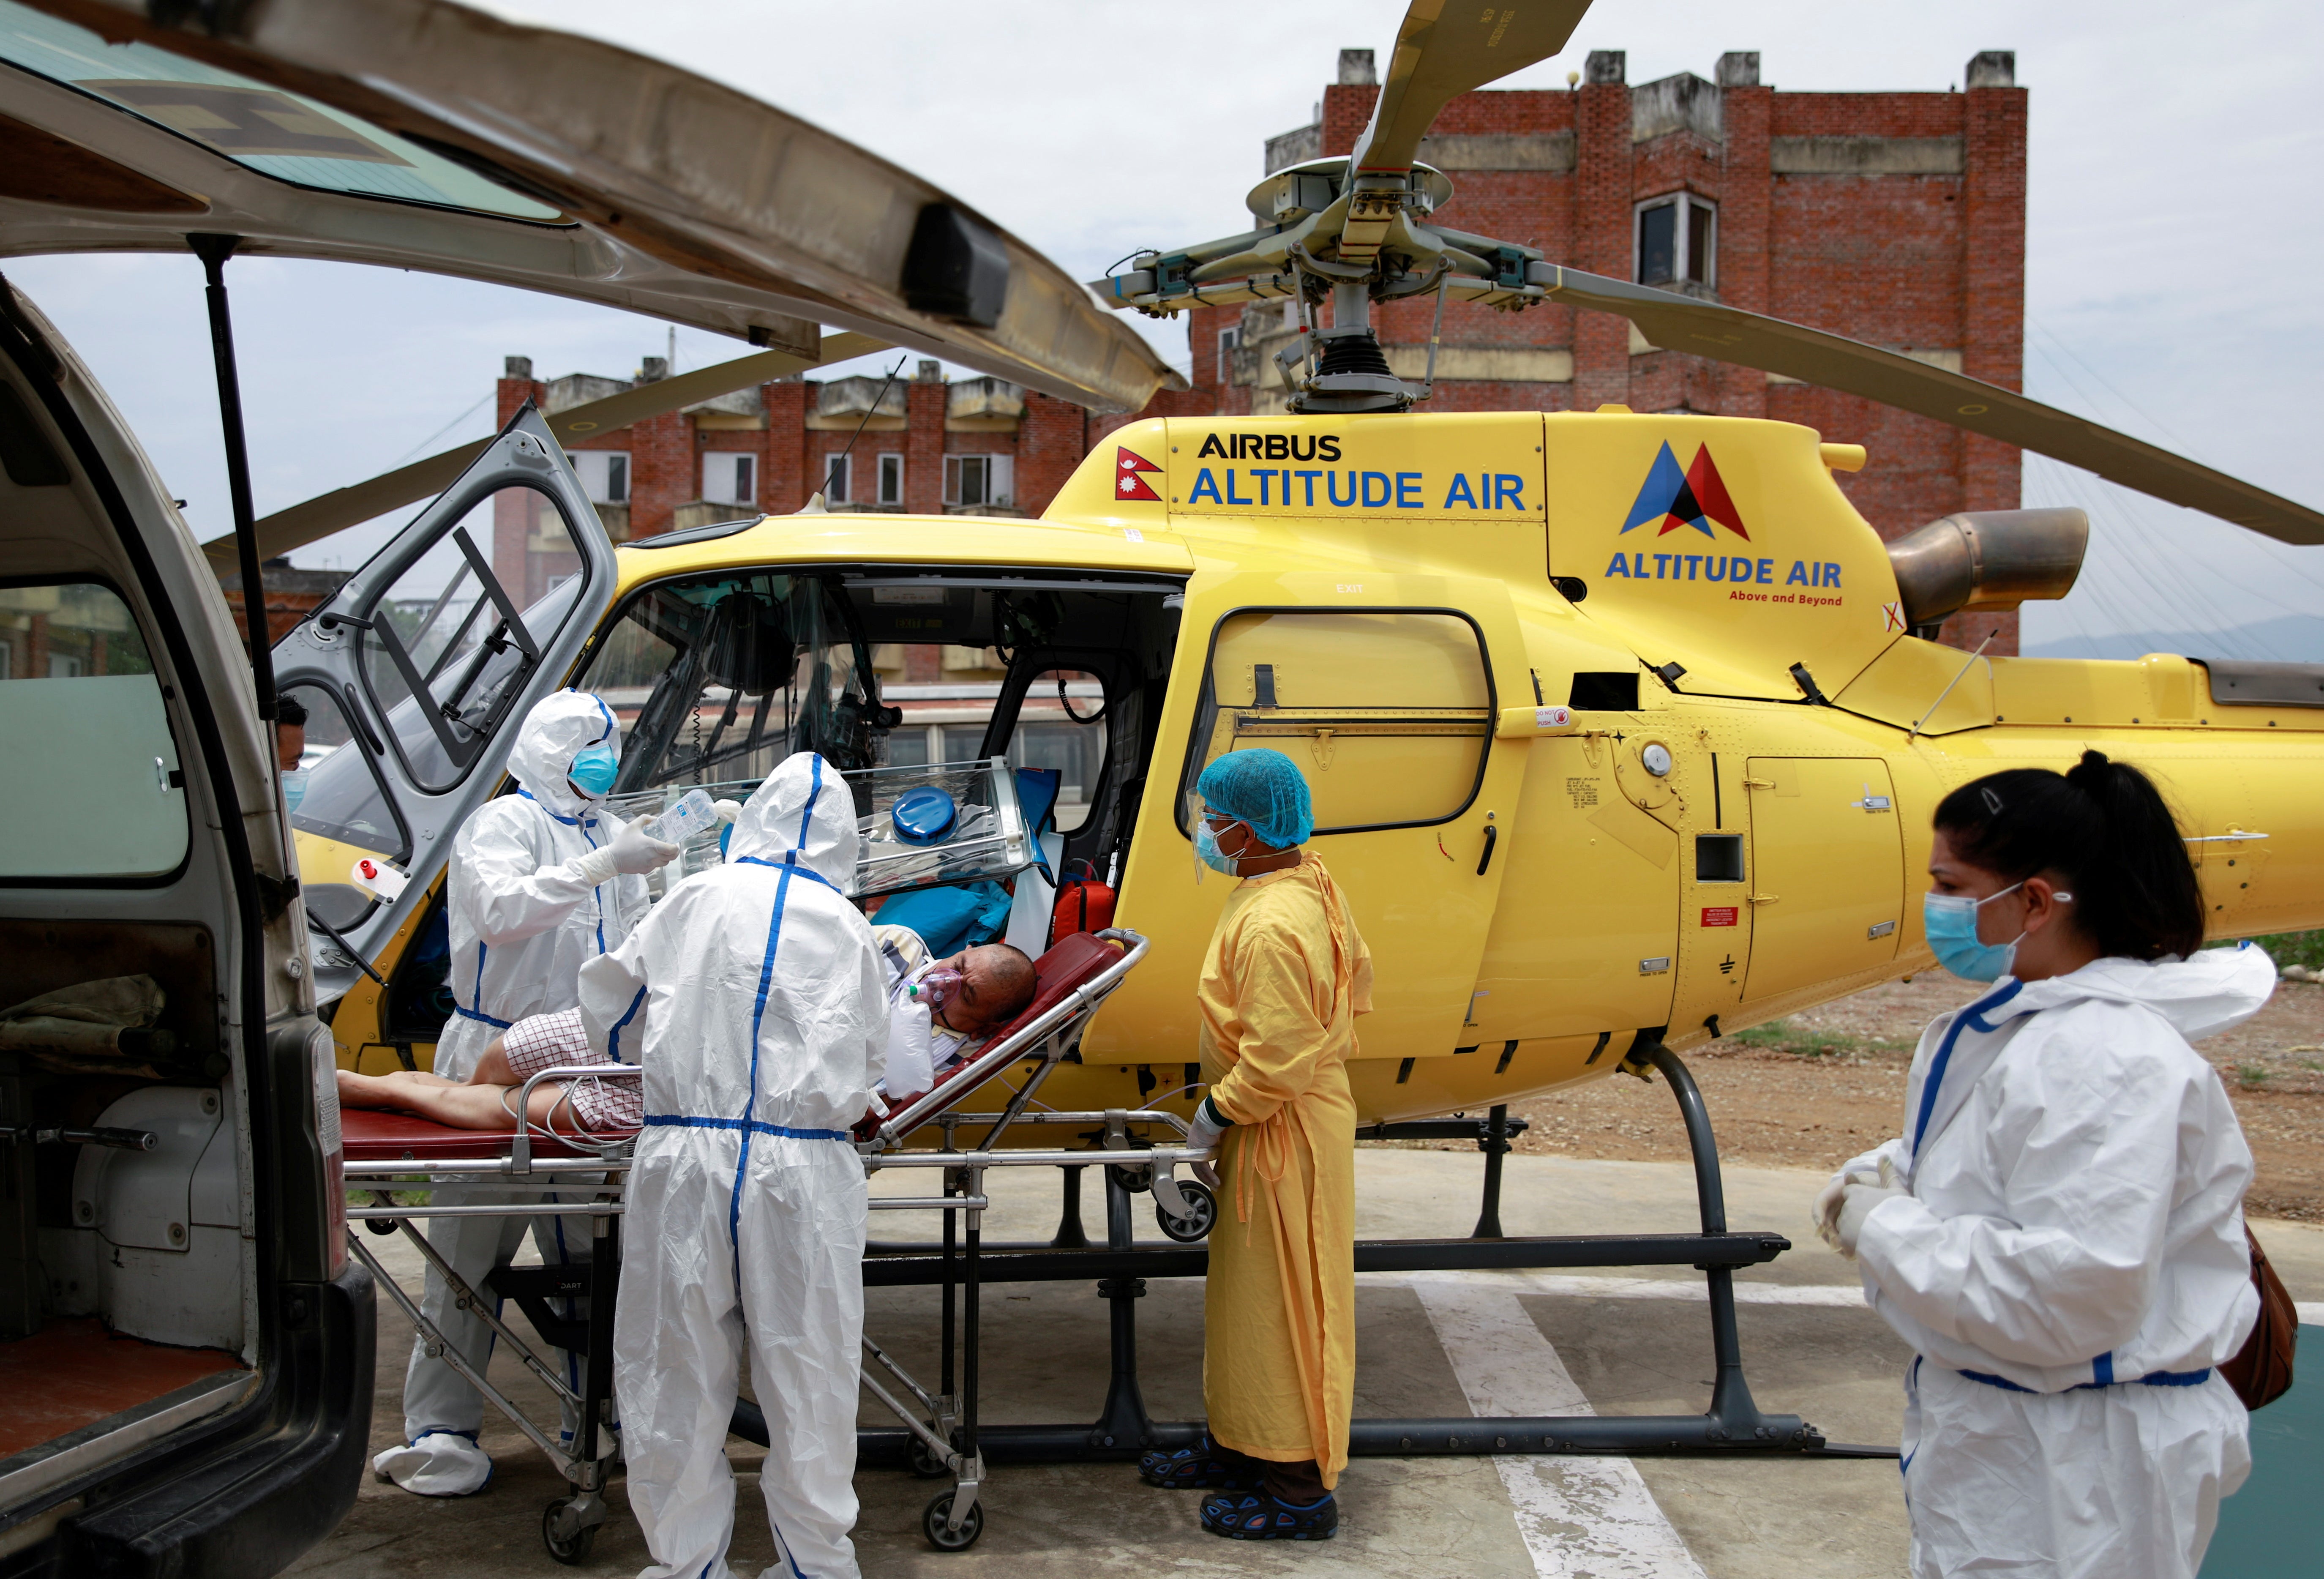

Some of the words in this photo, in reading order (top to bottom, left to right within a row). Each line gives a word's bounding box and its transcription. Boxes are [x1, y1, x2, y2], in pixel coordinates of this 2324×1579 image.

[1198, 433, 1341, 462] AIRBUS
[1188, 468, 1423, 508] ALTITUDE
[1444, 473, 1525, 511] AIR
[1605, 552, 1773, 584] ALTITUDE
[1786, 560, 1842, 588] AIR
[1337, 584, 1363, 593] EXIT
[1729, 590, 1768, 602] Above
[1773, 592, 1795, 603] and
[1799, 595, 1842, 606] Beyond
[897, 619, 919, 628] EXIT
[678, 805, 686, 816] RL
